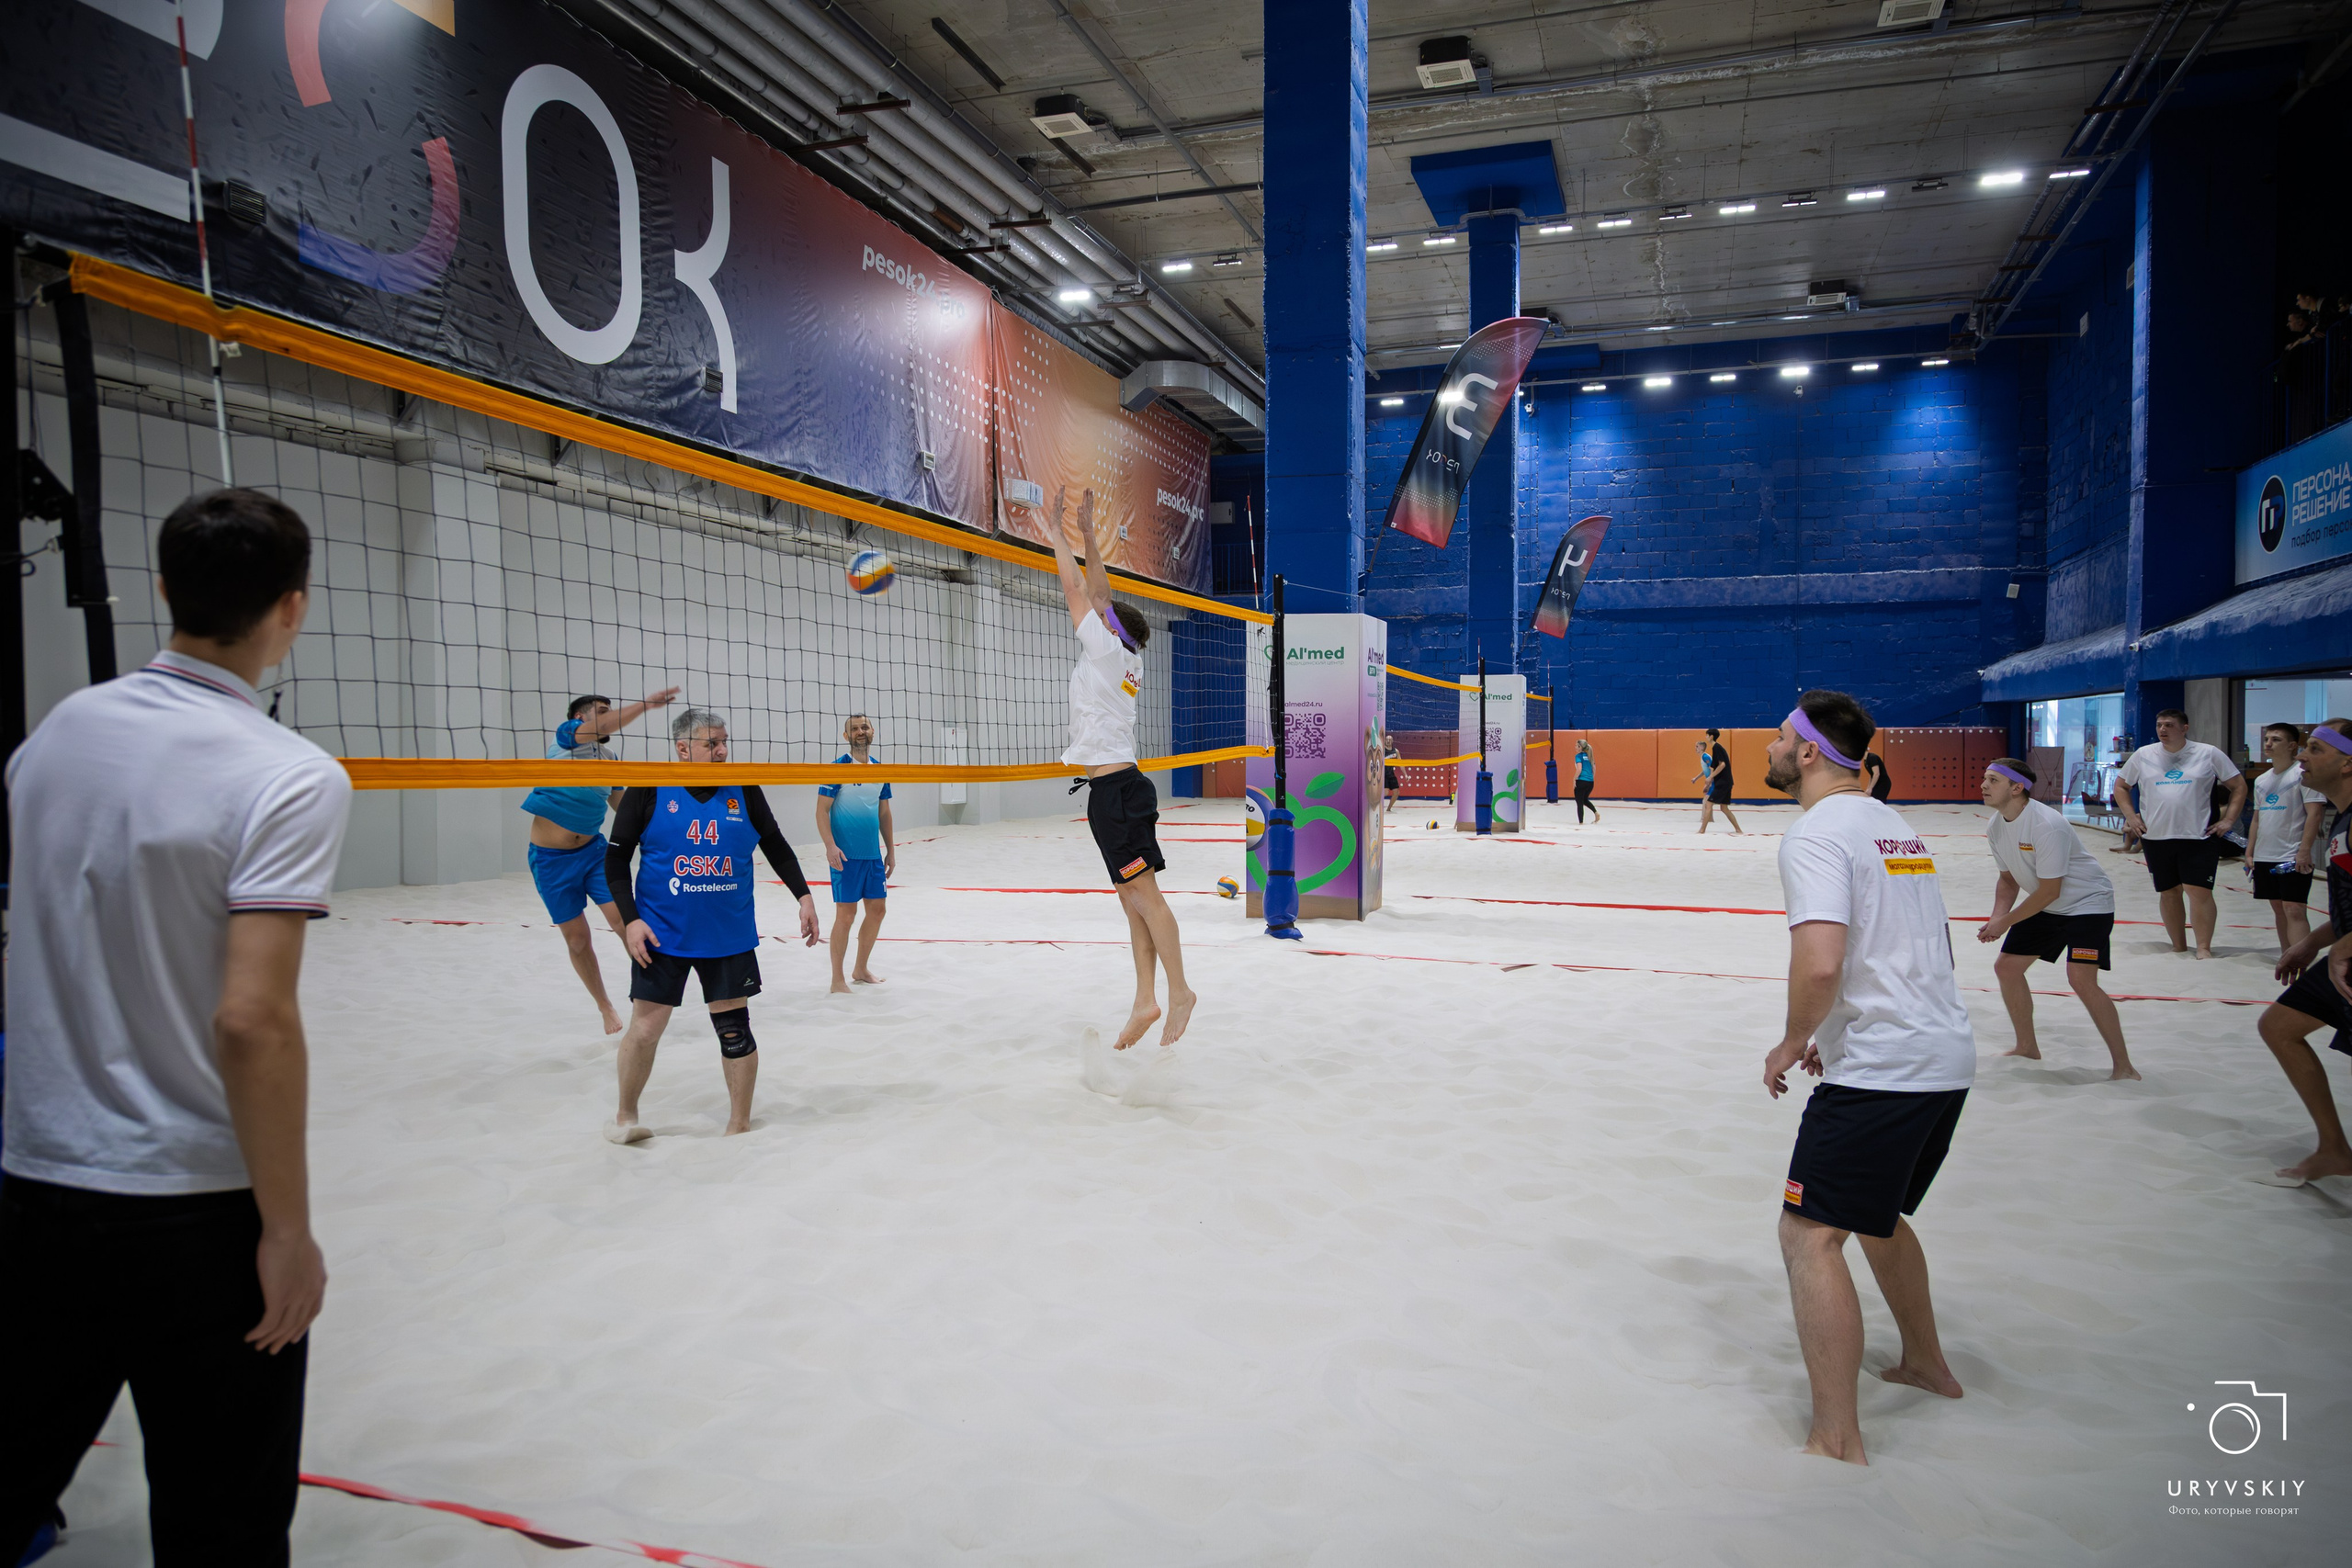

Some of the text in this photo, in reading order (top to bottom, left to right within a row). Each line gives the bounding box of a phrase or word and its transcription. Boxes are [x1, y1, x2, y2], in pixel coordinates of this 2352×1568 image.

[2292, 461, 2352, 503] ПЕРСОНА
[2292, 485, 2351, 527] РЕШЕНИЕ
[2290, 528, 2321, 548] подбор
[1286, 646, 1345, 660] Al'med
[686, 819, 719, 845] 44
[673, 855, 733, 876] CSKA
[683, 883, 738, 893] Rostelecom
